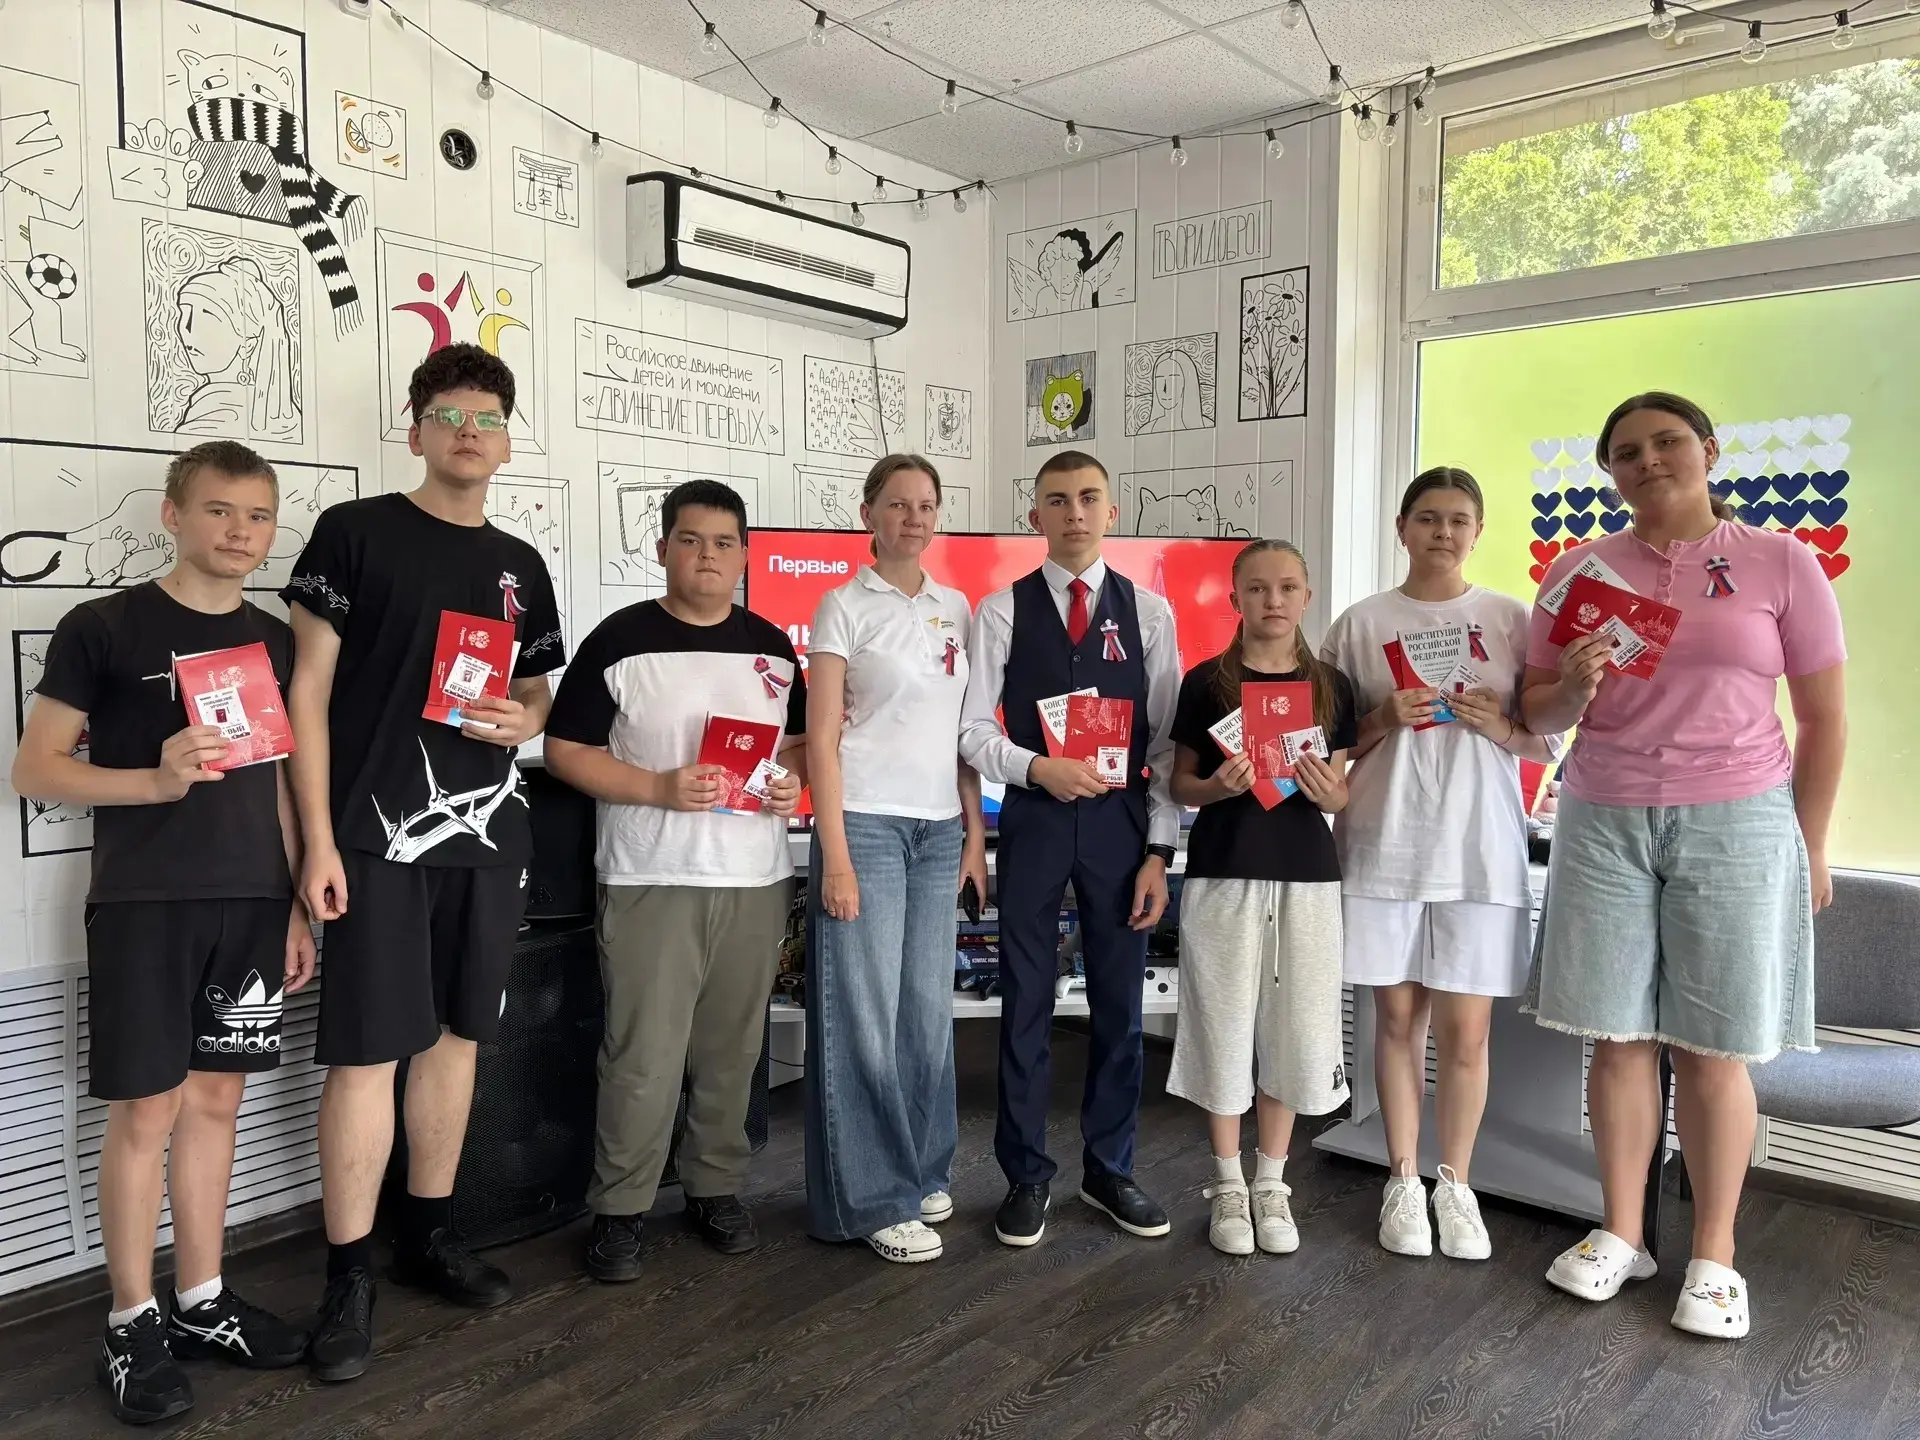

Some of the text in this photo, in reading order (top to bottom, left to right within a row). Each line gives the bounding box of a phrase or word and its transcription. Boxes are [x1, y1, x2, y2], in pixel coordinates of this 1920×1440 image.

[1156, 210, 1261, 272] ТВОРИ ДОБРО!
[606, 335, 687, 370] Российское
[631, 367, 675, 389] детей
[768, 555, 849, 578] Первые
[1404, 627, 1462, 642] КОНСТИТУЦИЯ
[1408, 637, 1461, 652] РОССИЙСКОЙ
[1412, 648, 1459, 662] ФЕДЕРАЦИИ
[197, 1031, 280, 1054] adida
[874, 1240, 908, 1258] crocs
